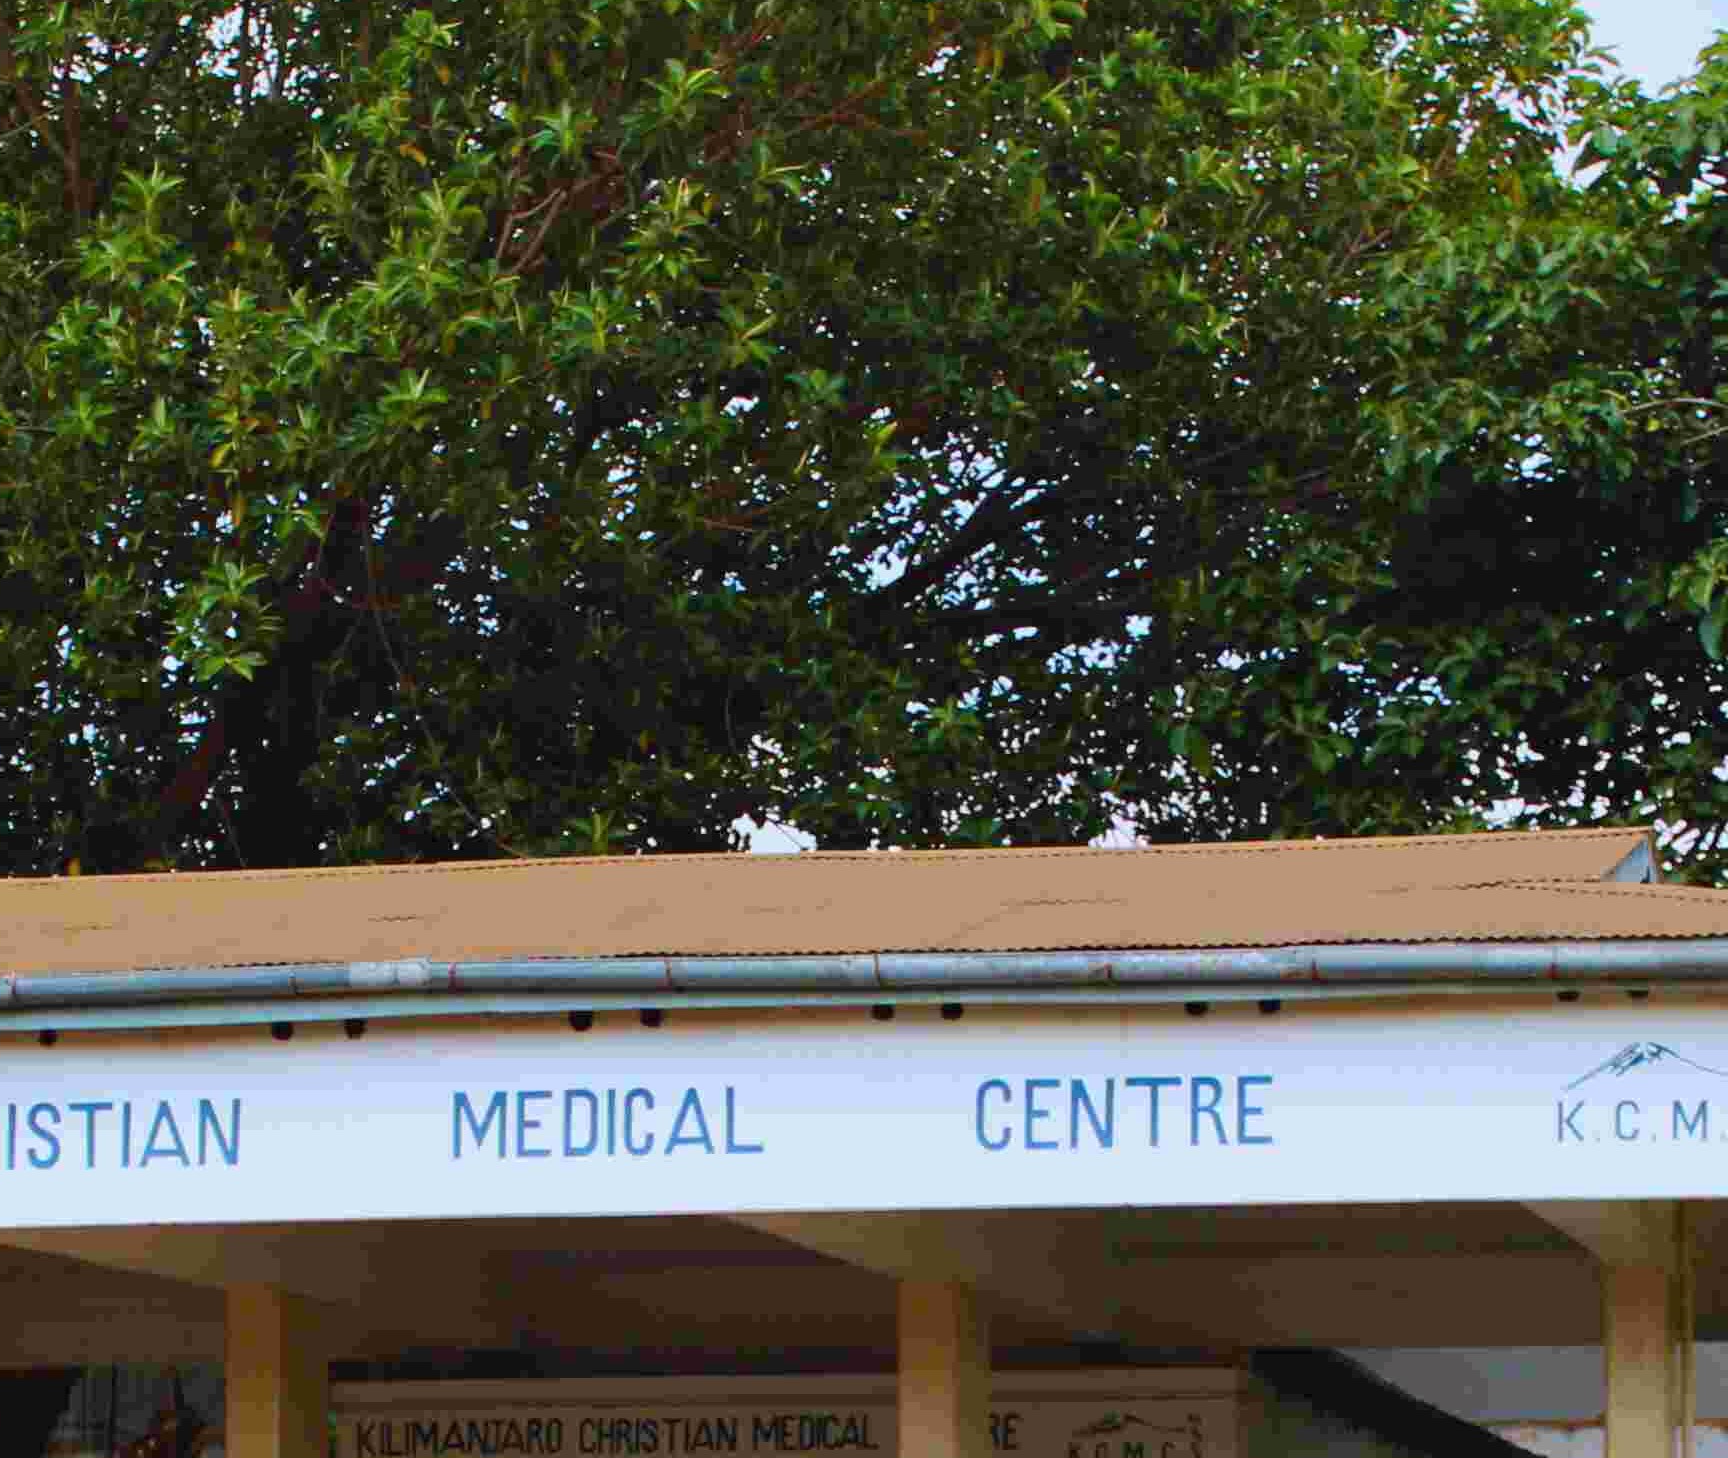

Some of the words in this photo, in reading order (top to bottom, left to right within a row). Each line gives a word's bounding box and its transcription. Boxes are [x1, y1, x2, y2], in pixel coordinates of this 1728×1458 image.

[452, 1086, 765, 1159] MEDICAL
[975, 1075, 1274, 1151] CENTRE
[356, 1416, 563, 1458] KILIMANJARO
[577, 1416, 739, 1456] CHRISTIAN
[752, 1410, 879, 1451] MEDICAL
